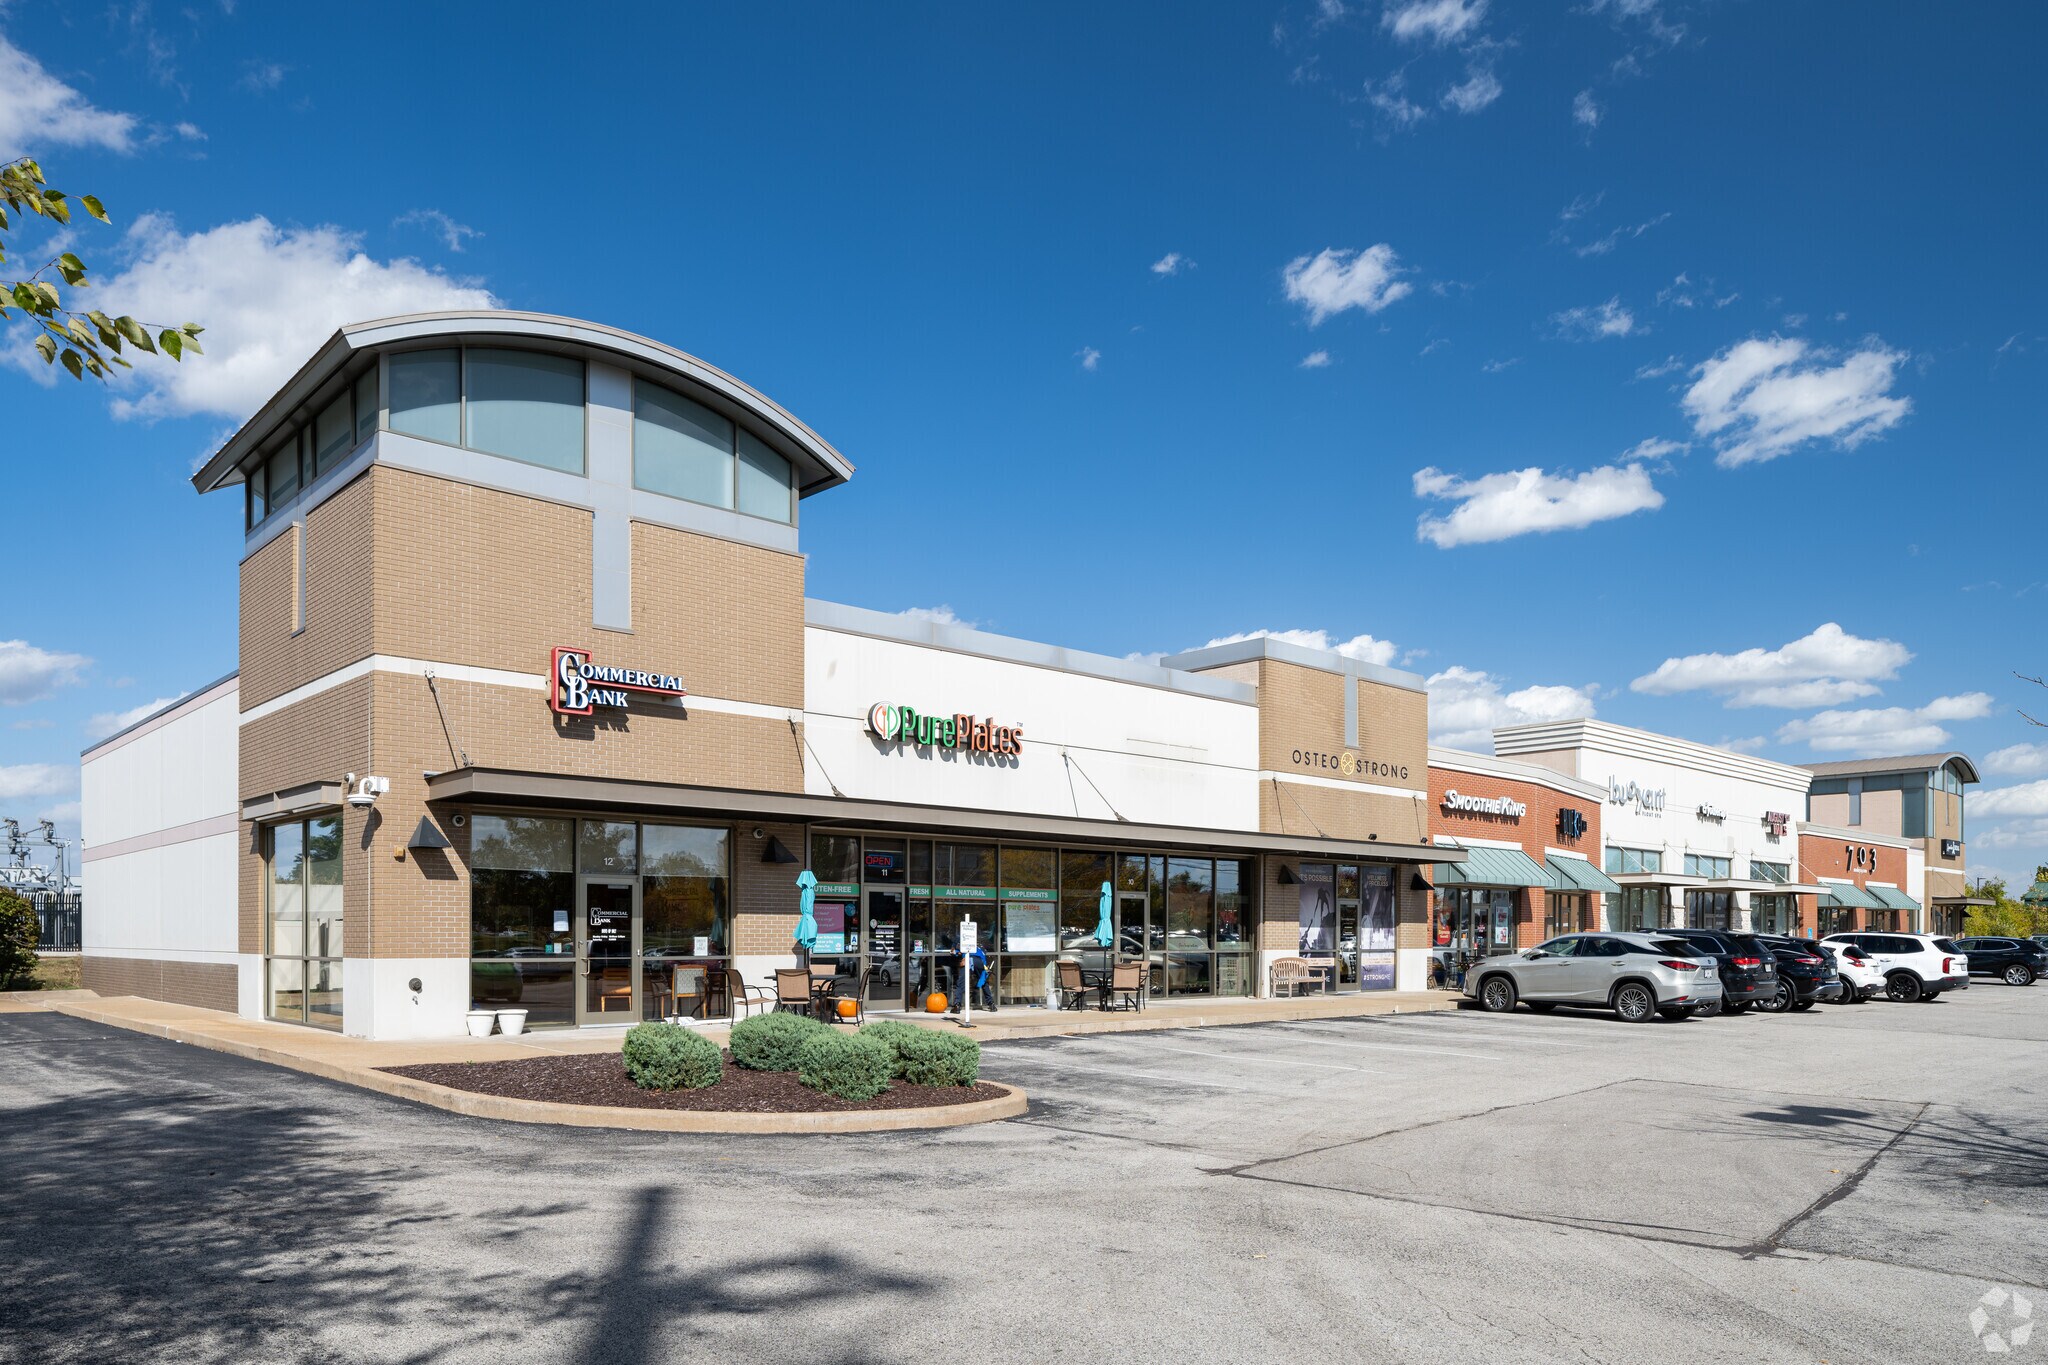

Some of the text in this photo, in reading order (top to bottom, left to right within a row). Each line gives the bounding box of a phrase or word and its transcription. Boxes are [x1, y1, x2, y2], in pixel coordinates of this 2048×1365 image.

[560, 652, 687, 691] COMMERCIAL
[566, 675, 629, 709] BANK
[1292, 749, 1408, 780] OSTEO STRONG
[1445, 789, 1501, 815] SMOOTHIE
[603, 857, 614, 866] 12
[865, 855, 891, 865] OPEN
[1308, 874, 1333, 883] POSSIBLE
[813, 885, 852, 893] UTEN-FREE
[909, 887, 930, 895] FRESH
[958, 889, 986, 897] NATURAL
[1008, 890, 1049, 899] SUPPLEMENTS
